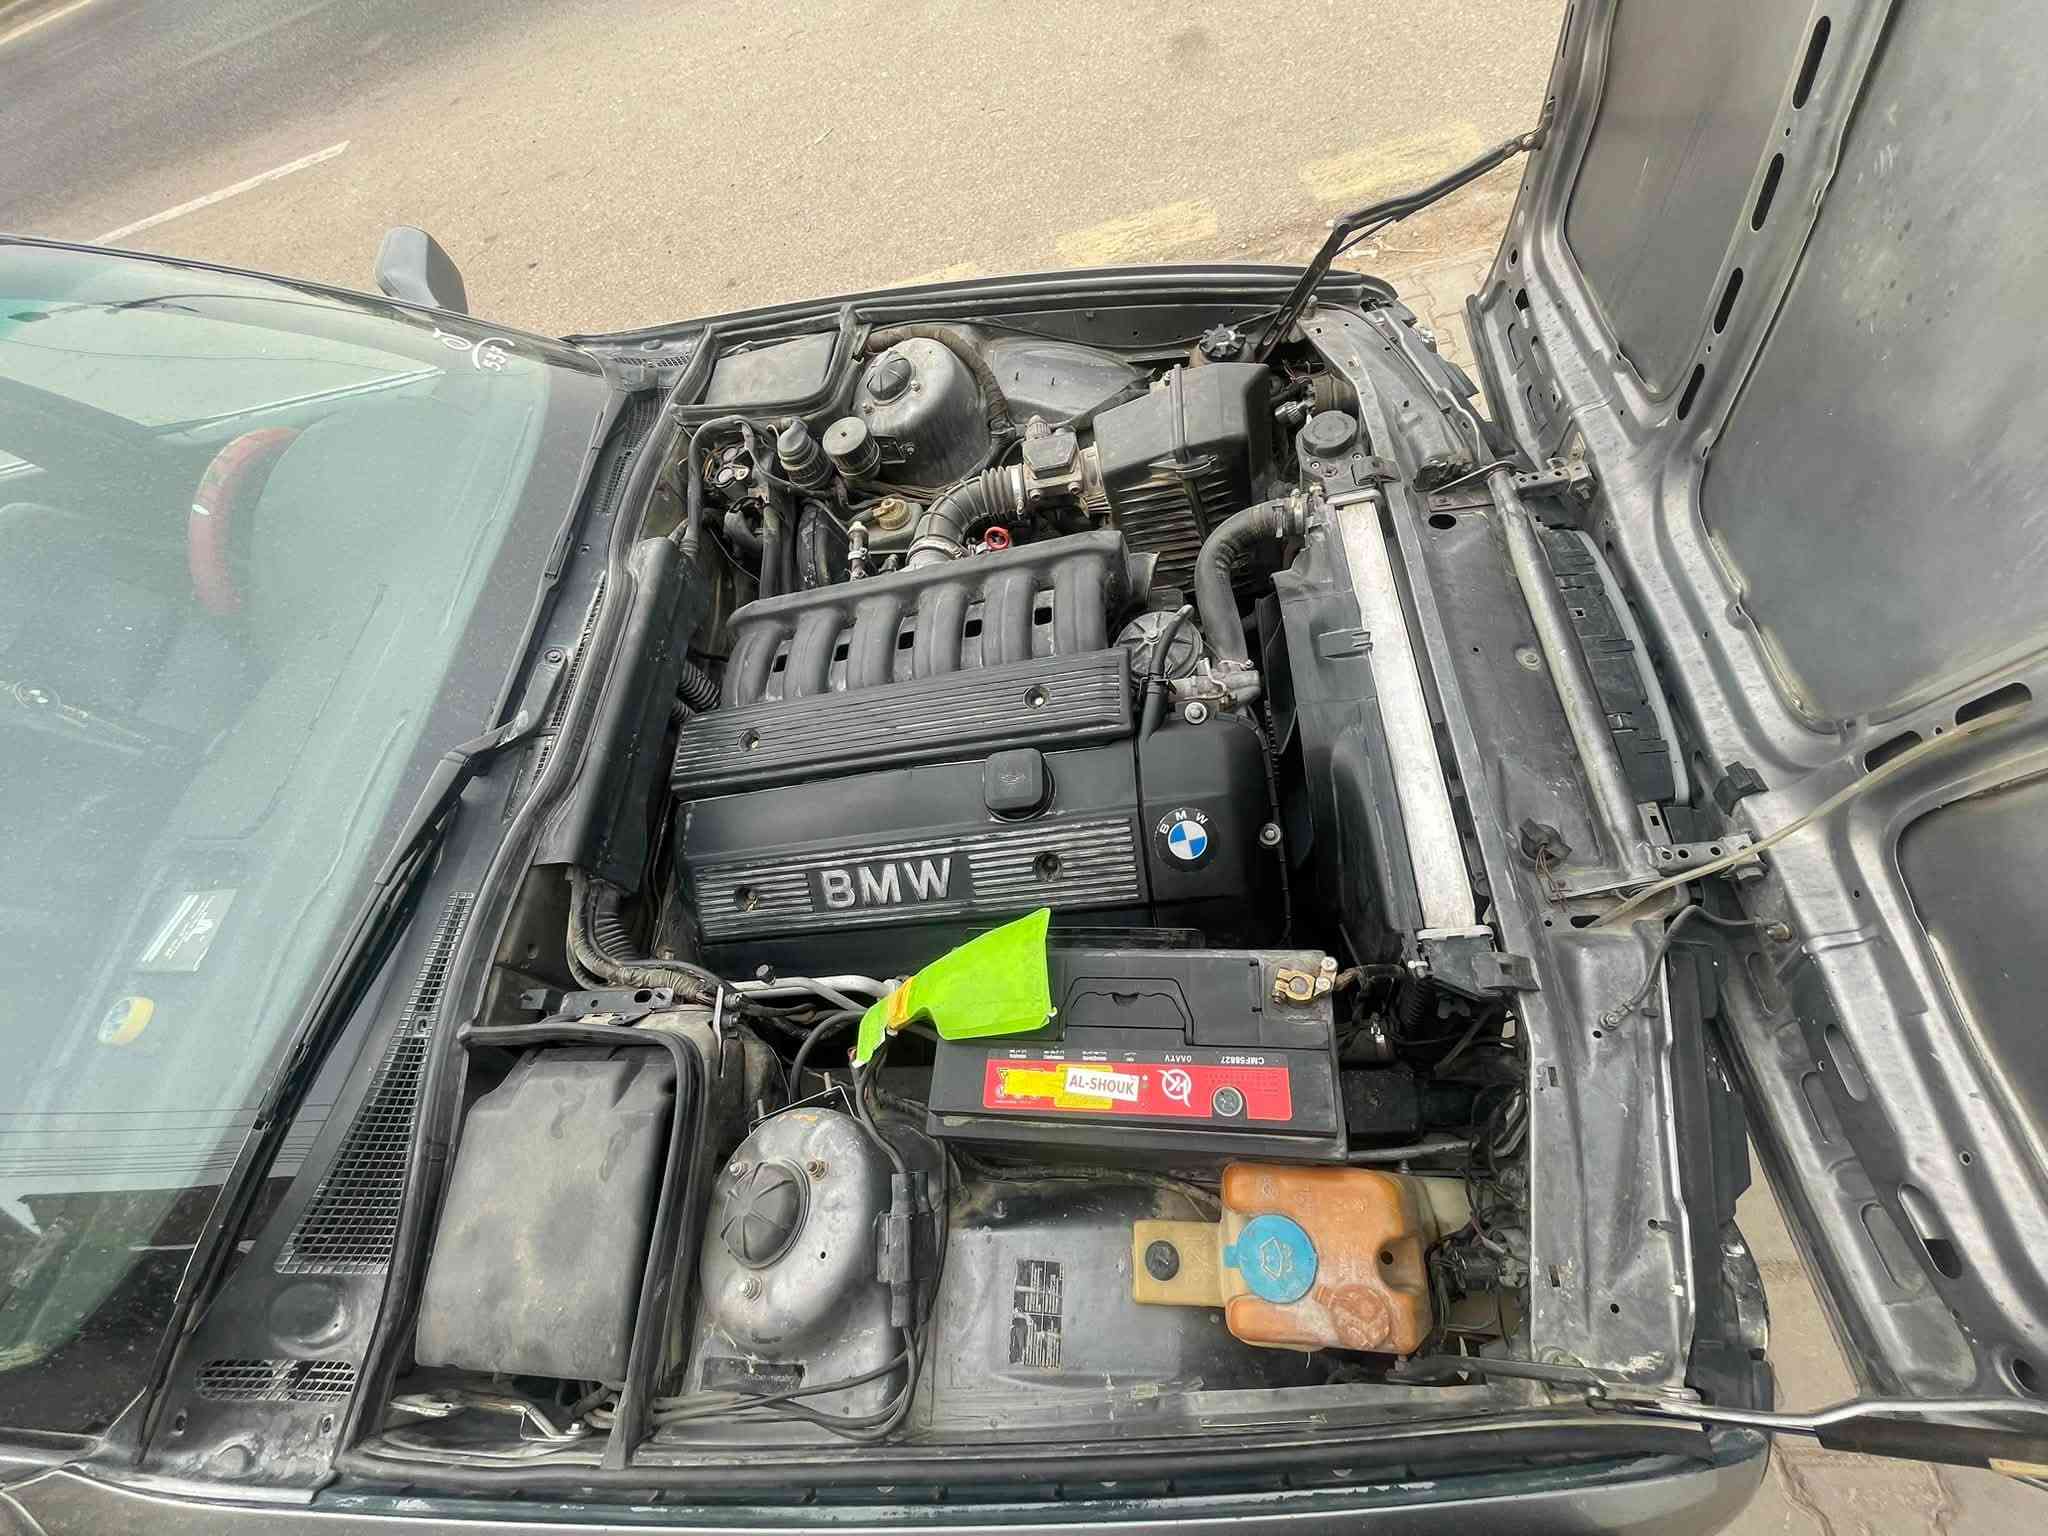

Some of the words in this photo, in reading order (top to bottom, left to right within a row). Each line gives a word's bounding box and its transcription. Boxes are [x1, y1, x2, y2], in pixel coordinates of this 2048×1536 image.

[1159, 810, 1209, 834] BMW
[819, 857, 953, 909] BMW
[1068, 1074, 1135, 1096] AL-SHOUK
